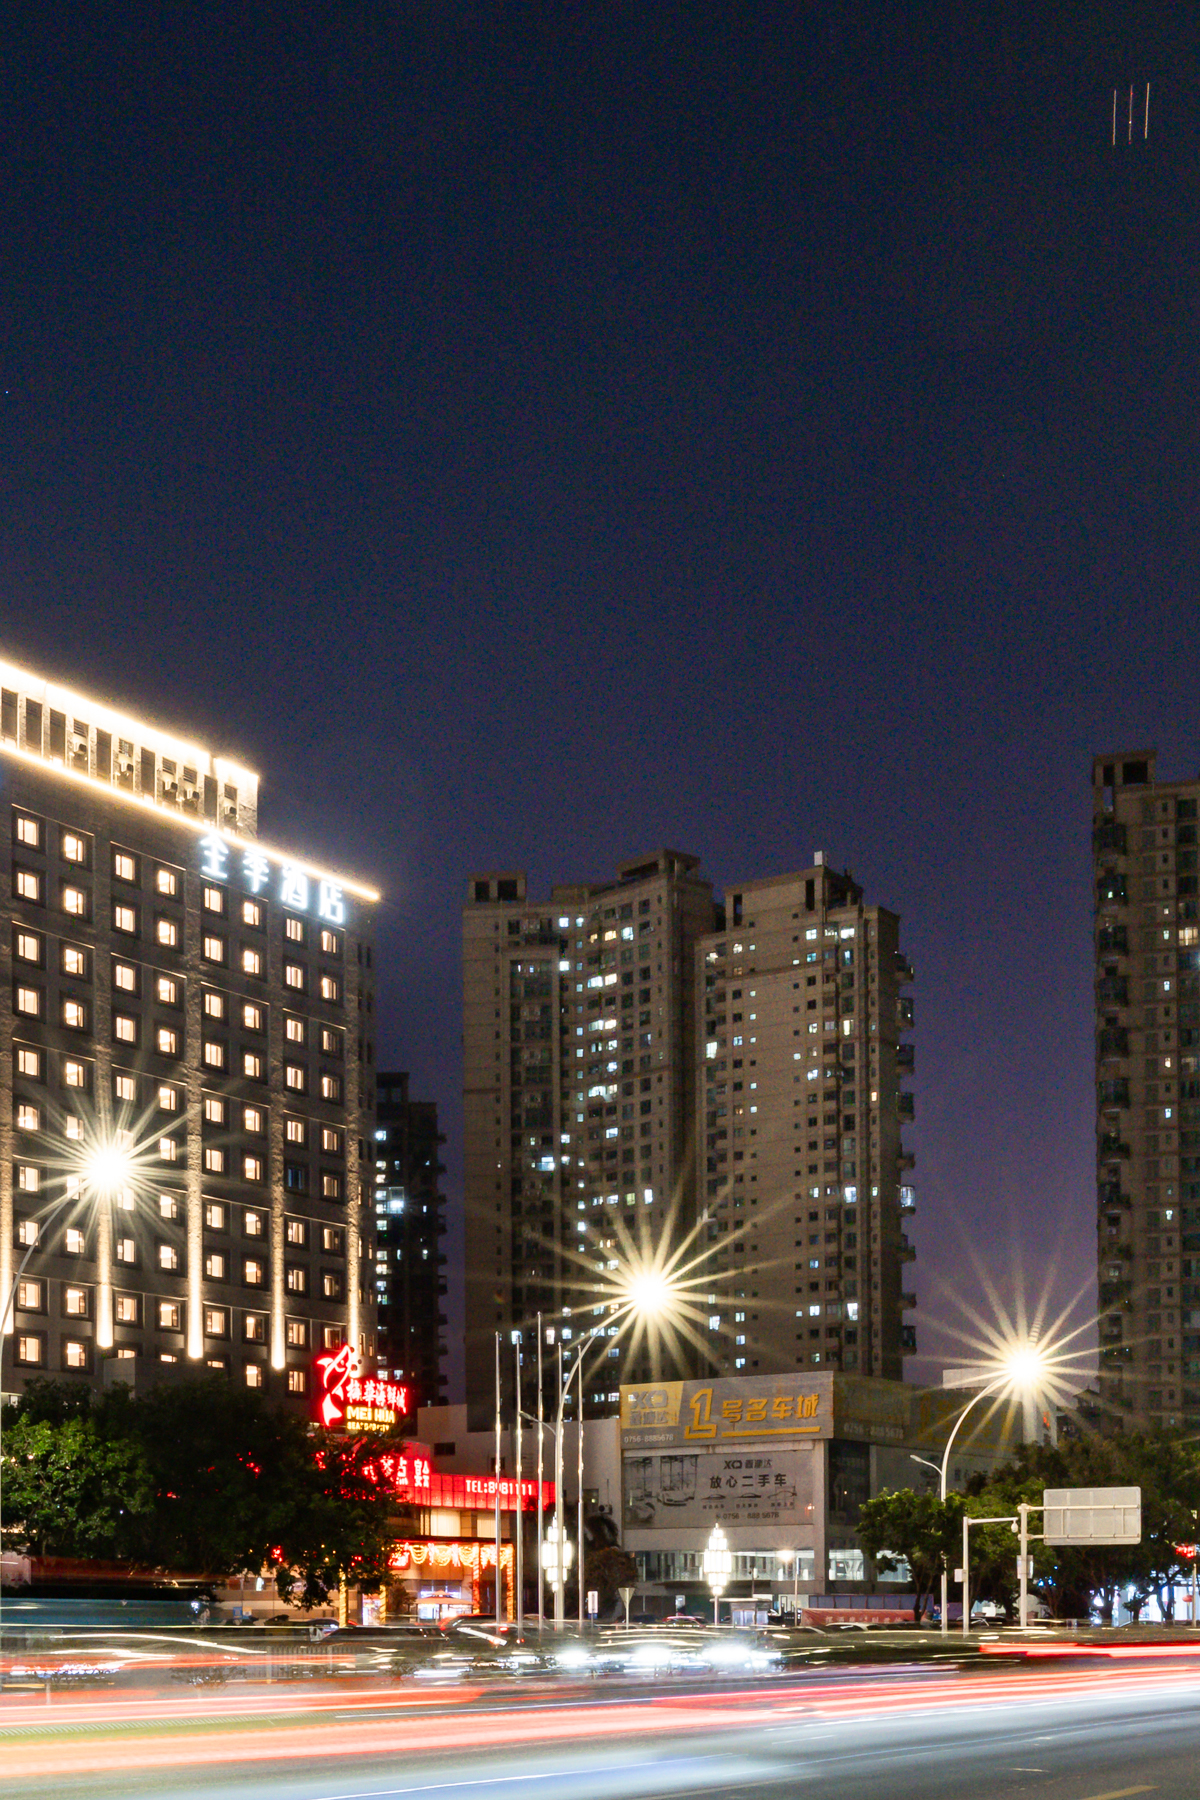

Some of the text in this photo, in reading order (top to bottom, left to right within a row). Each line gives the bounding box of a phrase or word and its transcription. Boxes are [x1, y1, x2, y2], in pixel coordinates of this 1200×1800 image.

[200, 834, 346, 924] 全季酒店
[374, 1408, 395, 1424] HUA
[709, 1472, 787, 1489] 放心二手车
